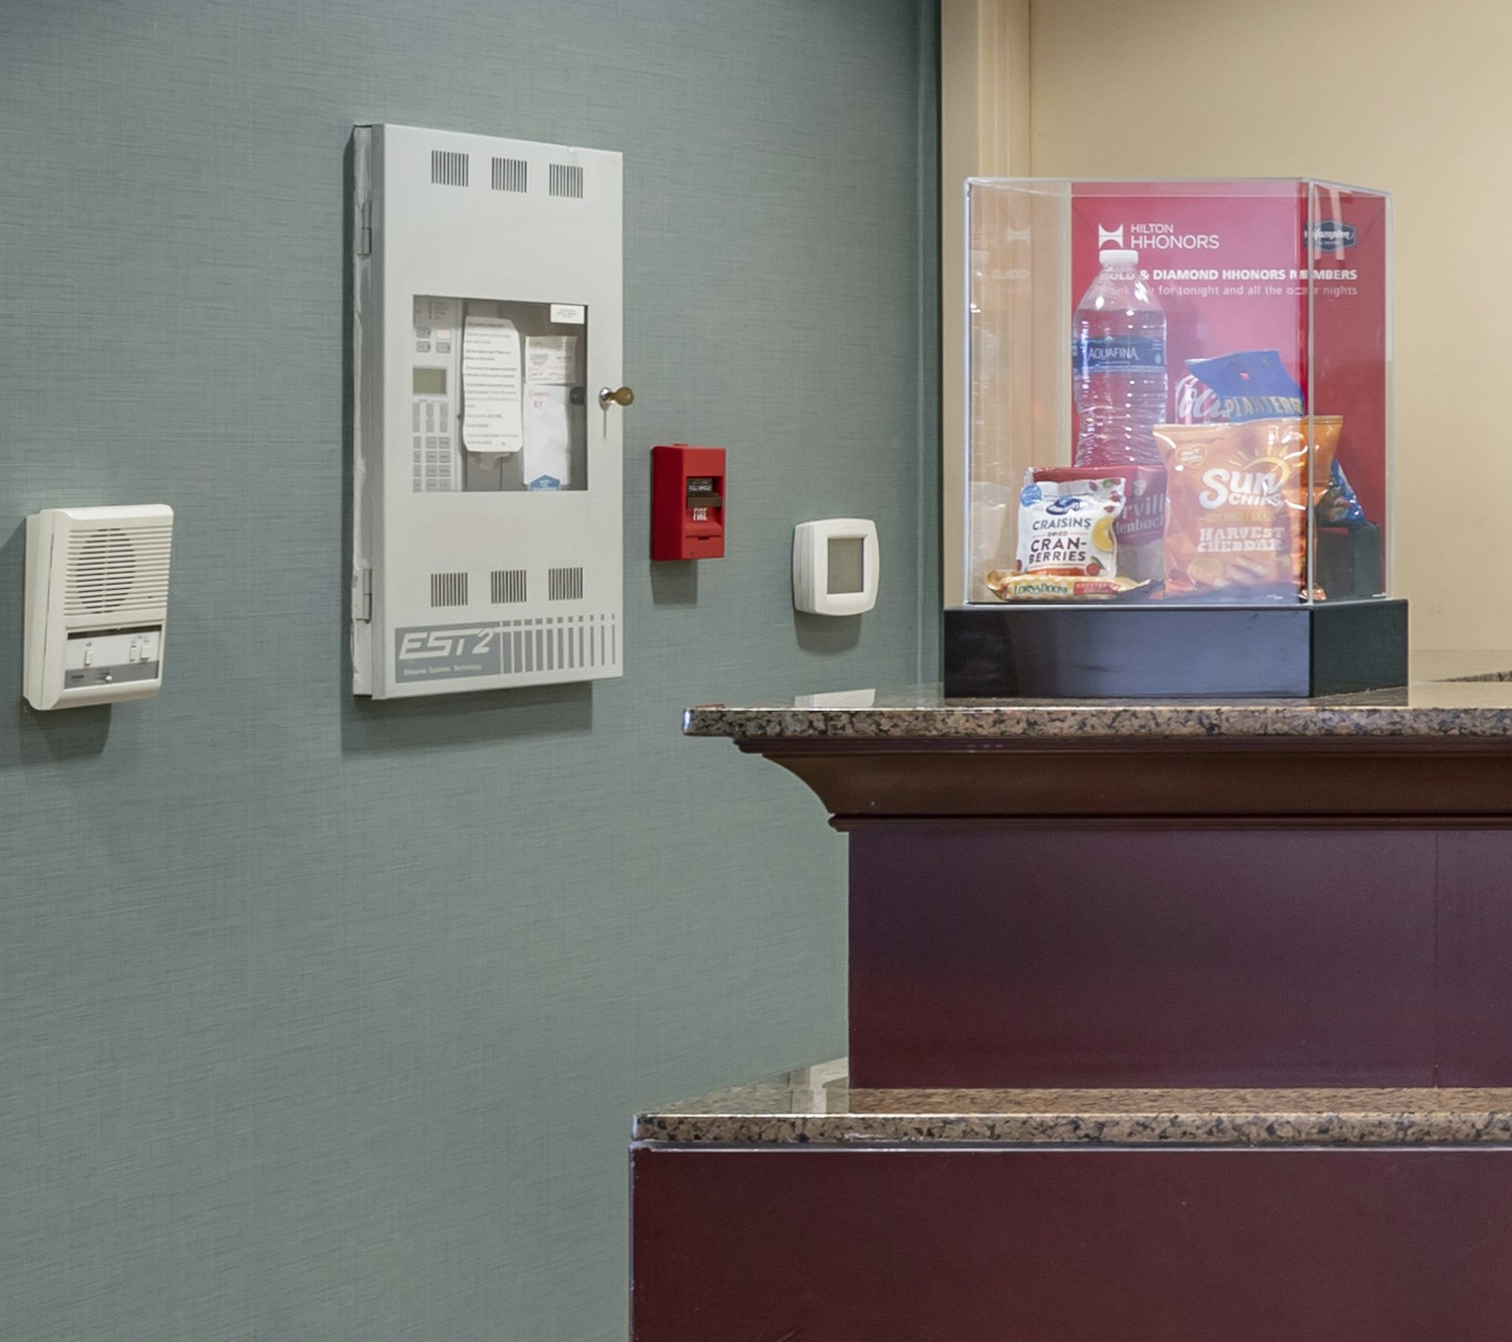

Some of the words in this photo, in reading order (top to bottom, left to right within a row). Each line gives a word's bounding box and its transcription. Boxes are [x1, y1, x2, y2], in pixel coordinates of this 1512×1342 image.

[1131, 223, 1174, 234] HILTON
[1130, 235, 1220, 250] HHONORS
[1140, 269, 1150, 280] &
[1152, 269, 1219, 280] DIAMOND
[1222, 269, 1286, 280] HHONORS
[1222, 285, 1244, 296] and
[1264, 285, 1283, 296] the
[1323, 285, 1358, 298] nights
[1088, 346, 1139, 361] AQUAFINA
[1032, 517, 1093, 531] CRAISINS
[1200, 526, 1285, 541] HARVEST
[1030, 537, 1088, 553] CRAN-
[1029, 550, 1087, 565] BERRIES
